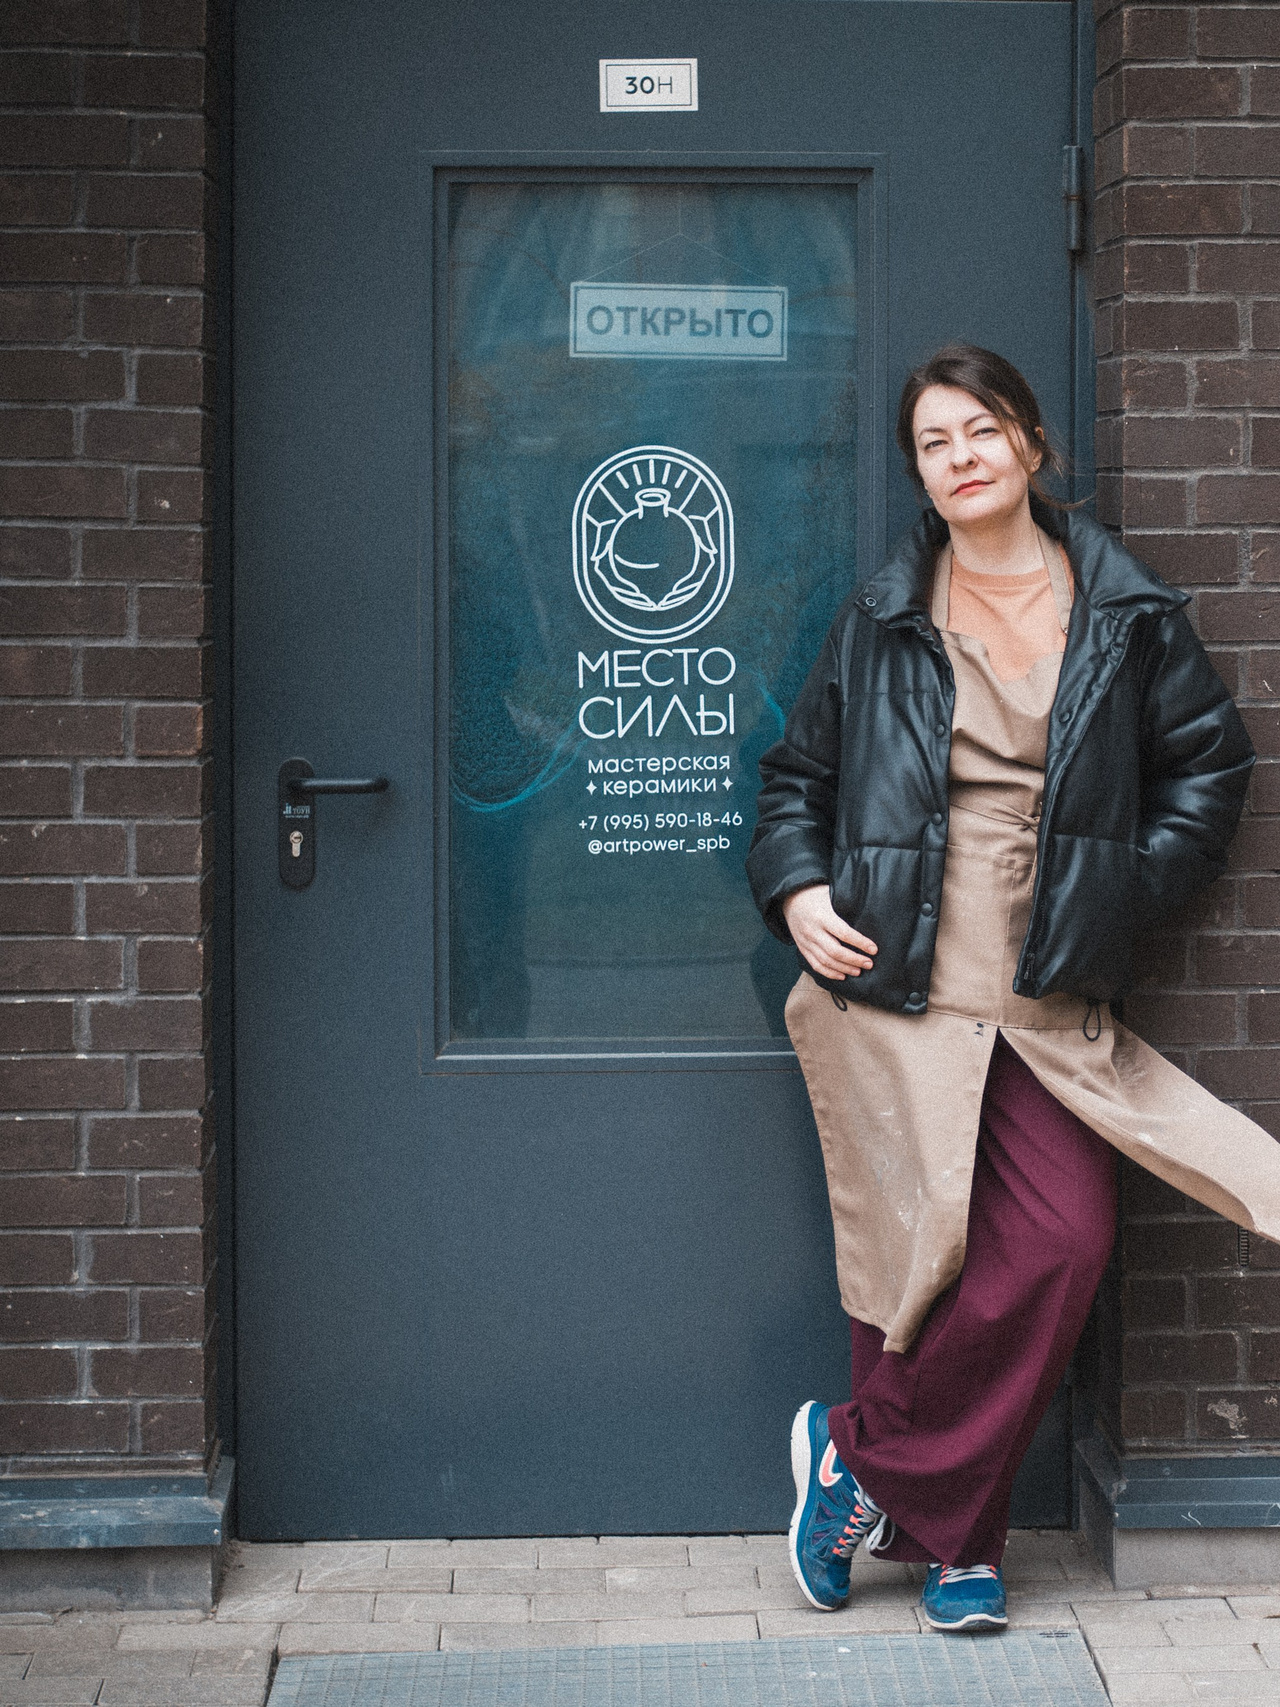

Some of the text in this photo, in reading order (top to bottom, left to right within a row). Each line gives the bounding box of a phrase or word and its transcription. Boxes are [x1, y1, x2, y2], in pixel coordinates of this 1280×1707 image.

[585, 304, 775, 339] ОТКРЫТО
[577, 646, 737, 689] МЕСТО
[577, 692, 736, 740] СИЛЫ
[587, 755, 731, 776] мастерская
[602, 777, 718, 799] керамики
[578, 811, 743, 833] +7 (995) 590-18-46
[587, 834, 731, 855] @artpower_spb
